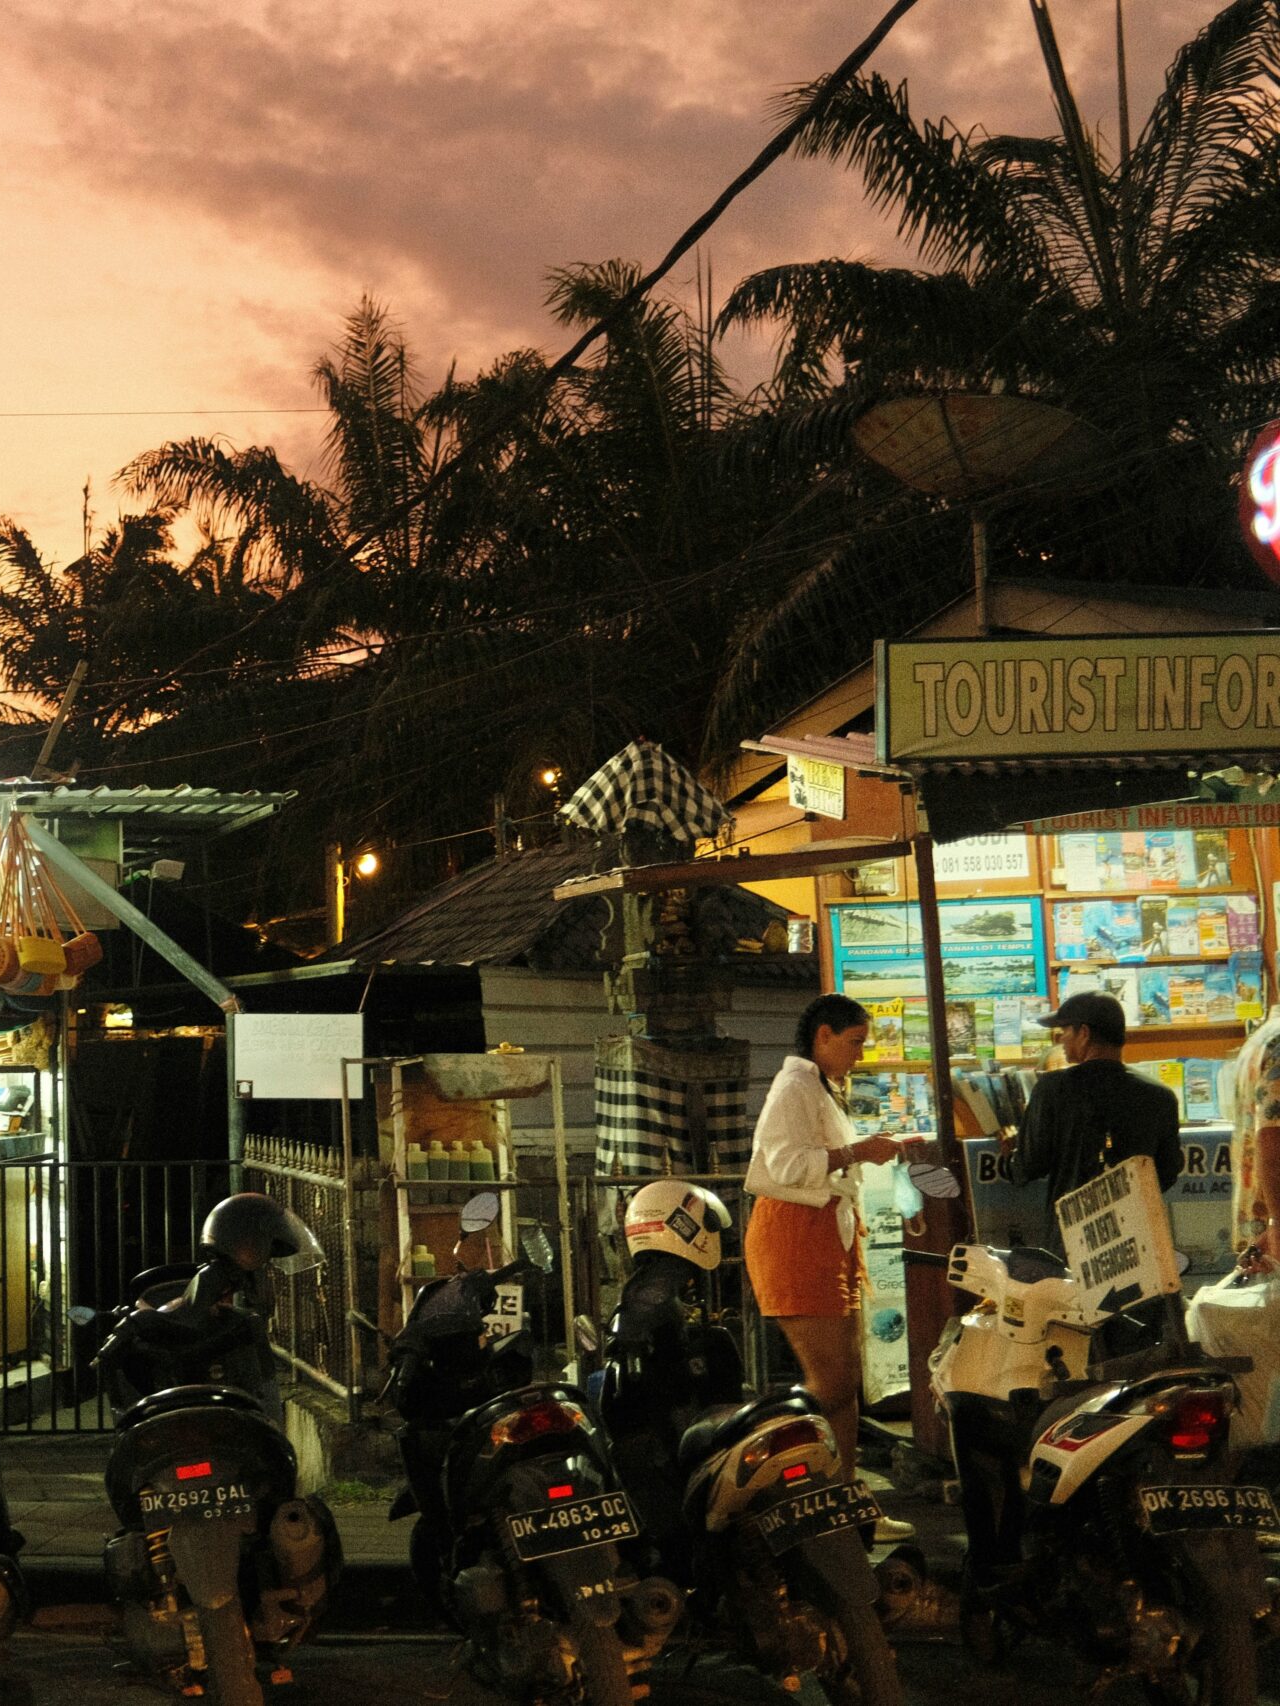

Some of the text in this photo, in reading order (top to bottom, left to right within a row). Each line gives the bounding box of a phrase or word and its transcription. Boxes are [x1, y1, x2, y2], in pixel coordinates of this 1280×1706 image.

[913, 652, 1280, 738] TOURIST INFOR
[143, 1484, 250, 1512] DK 2692 GAL
[1144, 1490, 1174, 1512] DK
[1177, 1488, 1230, 1509] 2696
[511, 1516, 537, 1538] DK
